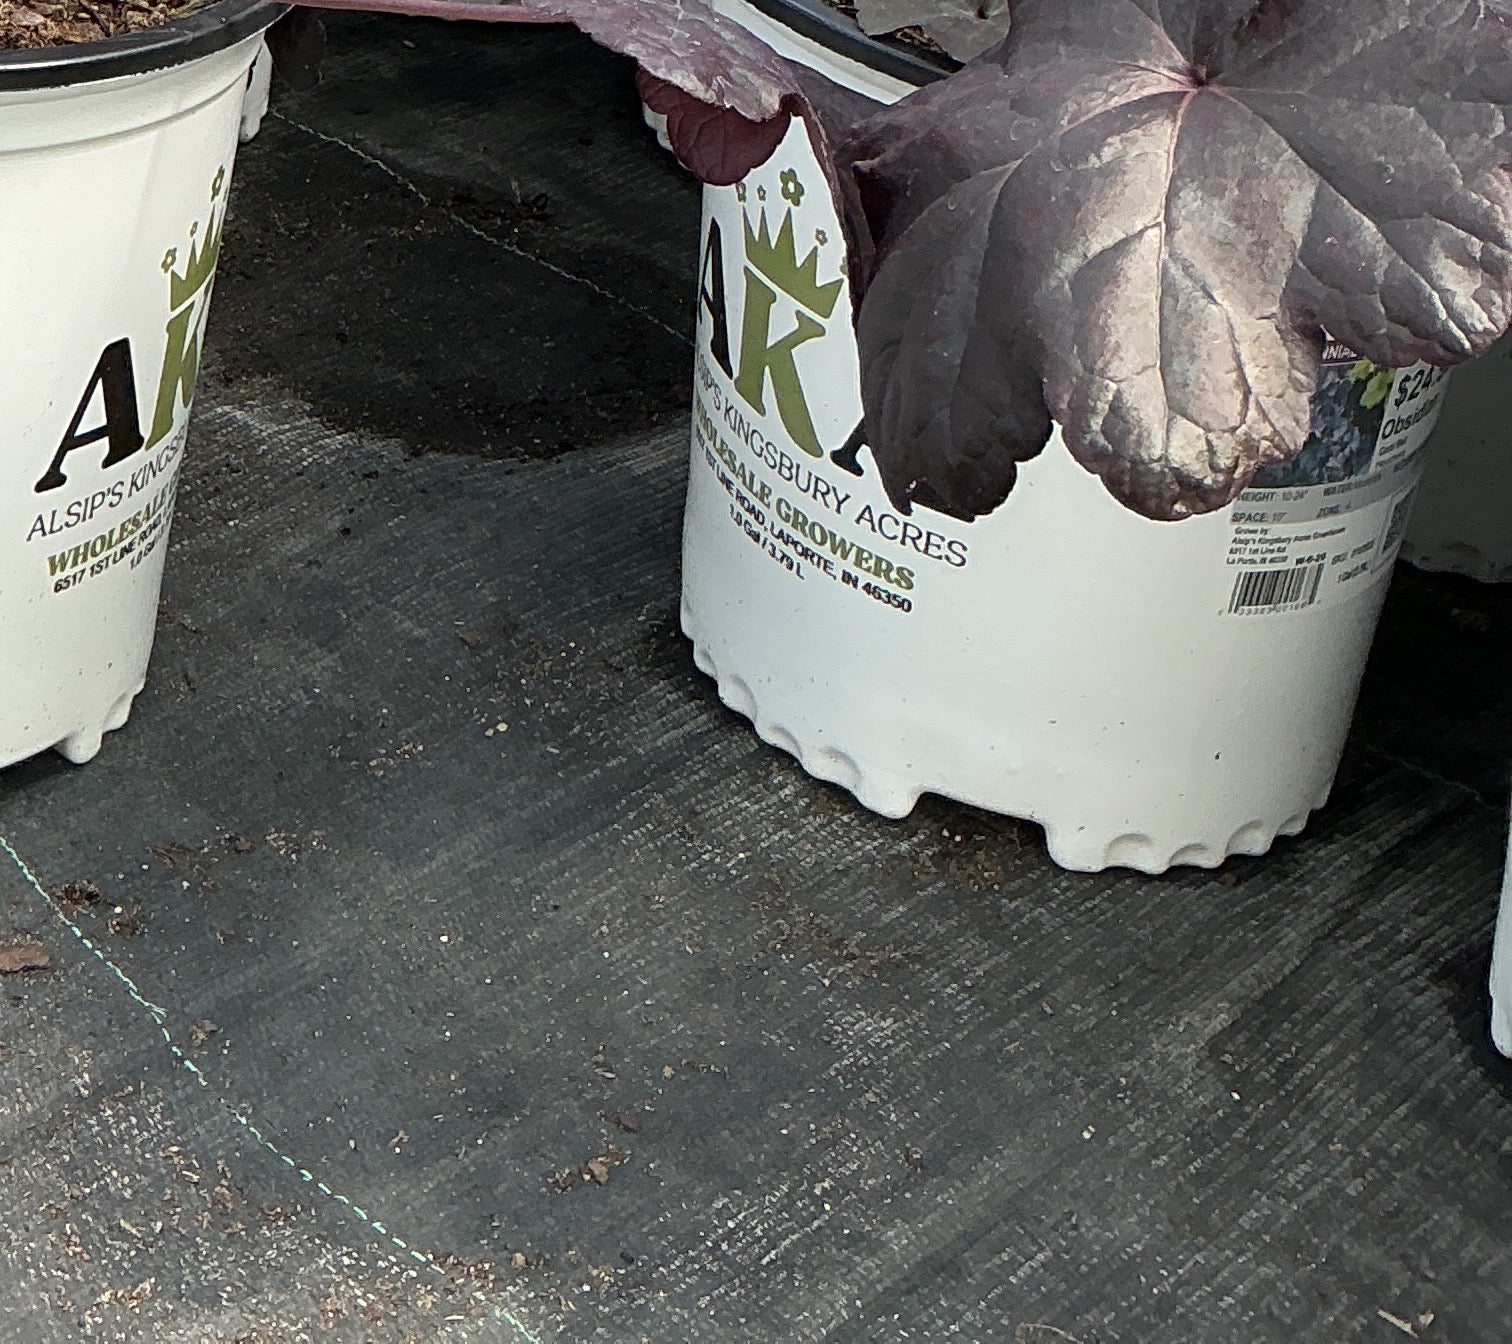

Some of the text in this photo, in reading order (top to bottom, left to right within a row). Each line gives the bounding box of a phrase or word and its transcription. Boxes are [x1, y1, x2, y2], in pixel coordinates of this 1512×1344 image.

[698, 216, 870, 477] AK
[25, 480, 125, 542] ALSIP'S
[723, 396, 851, 515] KINGSBURY
[854, 504, 969, 567] ACRES
[770, 519, 837, 581] LAPORTE,
[841, 568, 860, 591] IN
[775, 496, 916, 591] GROWERS
